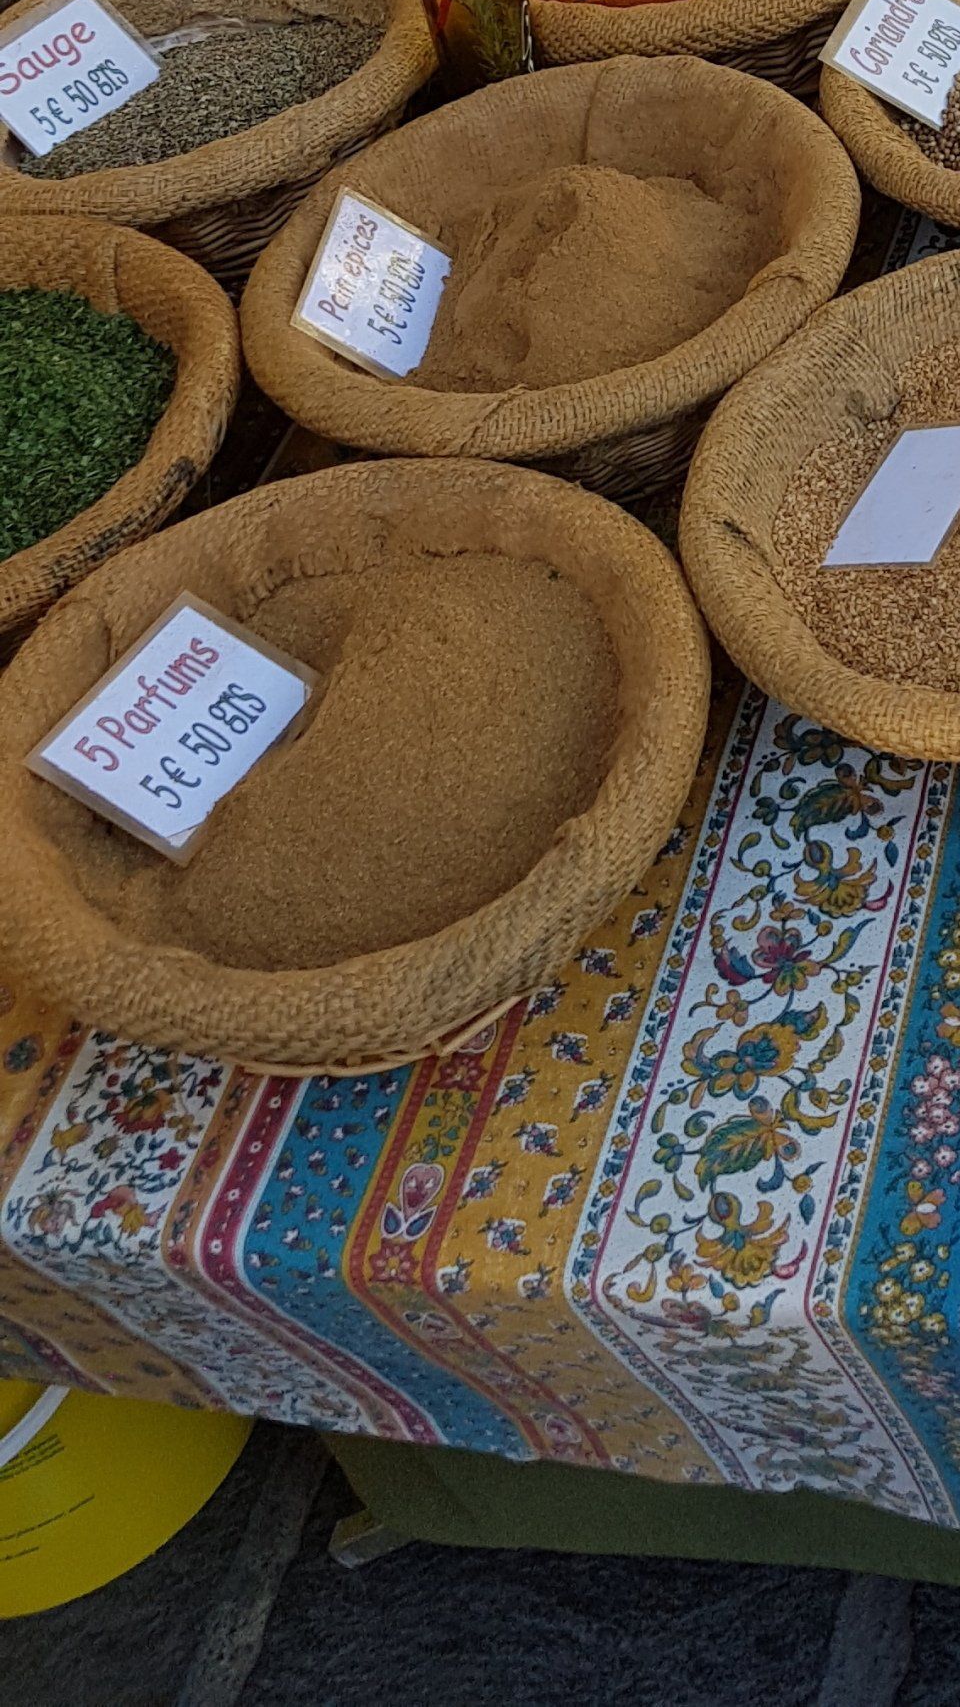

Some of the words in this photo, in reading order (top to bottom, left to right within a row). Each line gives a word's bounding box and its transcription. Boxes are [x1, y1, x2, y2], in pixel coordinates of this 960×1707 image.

[0, 22, 96, 95] Sauge
[917, 40, 951, 68] 50
[902, 61, 940, 95] 5€
[29, 97, 73, 136] 5€
[62, 80, 99, 113] 50
[379, 278, 416, 313] 50
[367, 304, 407, 345] 5€
[96, 637, 220, 750] Parfums
[74, 735, 120, 772] 5
[139, 755, 202, 810] 5€
[178, 722, 232, 766] 50
